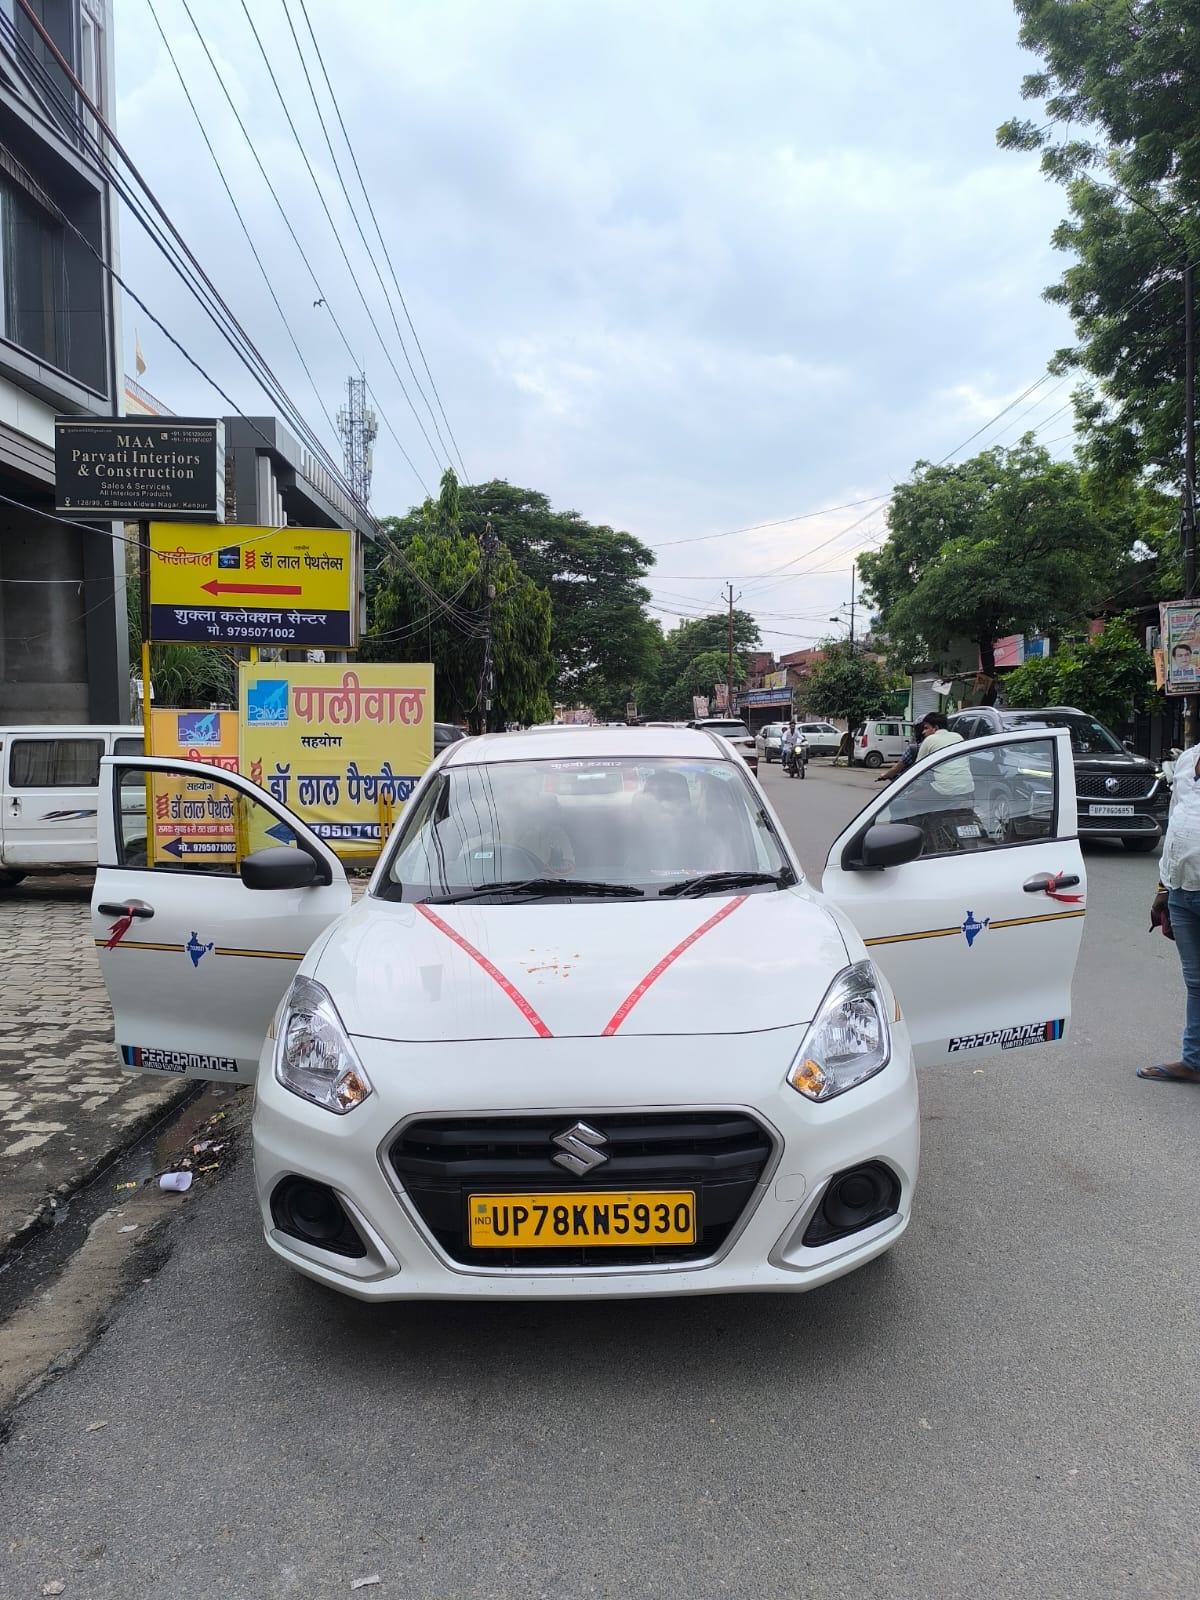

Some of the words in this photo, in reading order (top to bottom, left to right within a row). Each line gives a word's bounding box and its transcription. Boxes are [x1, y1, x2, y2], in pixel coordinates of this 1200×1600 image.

[116, 435, 155, 448] MAA
[72, 450, 128, 463] Parvati
[132, 450, 200, 465] Interiors
[77, 464, 89, 477] &
[95, 464, 195, 479] Construction
[101, 482, 125, 490] Sales
[142, 490, 172, 498] Products
[260, 552, 273, 569] डॉ
[277, 555, 300, 570] लाल
[174, 609, 216, 625] शुक्ला
[220, 609, 283, 625] कलेक्शन
[287, 610, 327, 625] सेन्टर
[206, 623, 224, 637] मो.
[227, 627, 296, 638] 9795071002
[292, 671, 427, 726] पालीवाल
[301, 732, 343, 748] सहयोग
[186, 782, 214, 791] सहयोग
[267, 763, 291, 804] डॉ
[297, 775, 341, 806] लाल
[171, 794, 183, 819] डॉ
[183, 800, 205, 819] लाल
[950, 1022, 1047, 1052] PERFORMANCE
[140, 1048, 235, 1071] PERFORMANCE
[474, 1216, 492, 1225] IND
[492, 1203, 690, 1236] UP78KN5930
